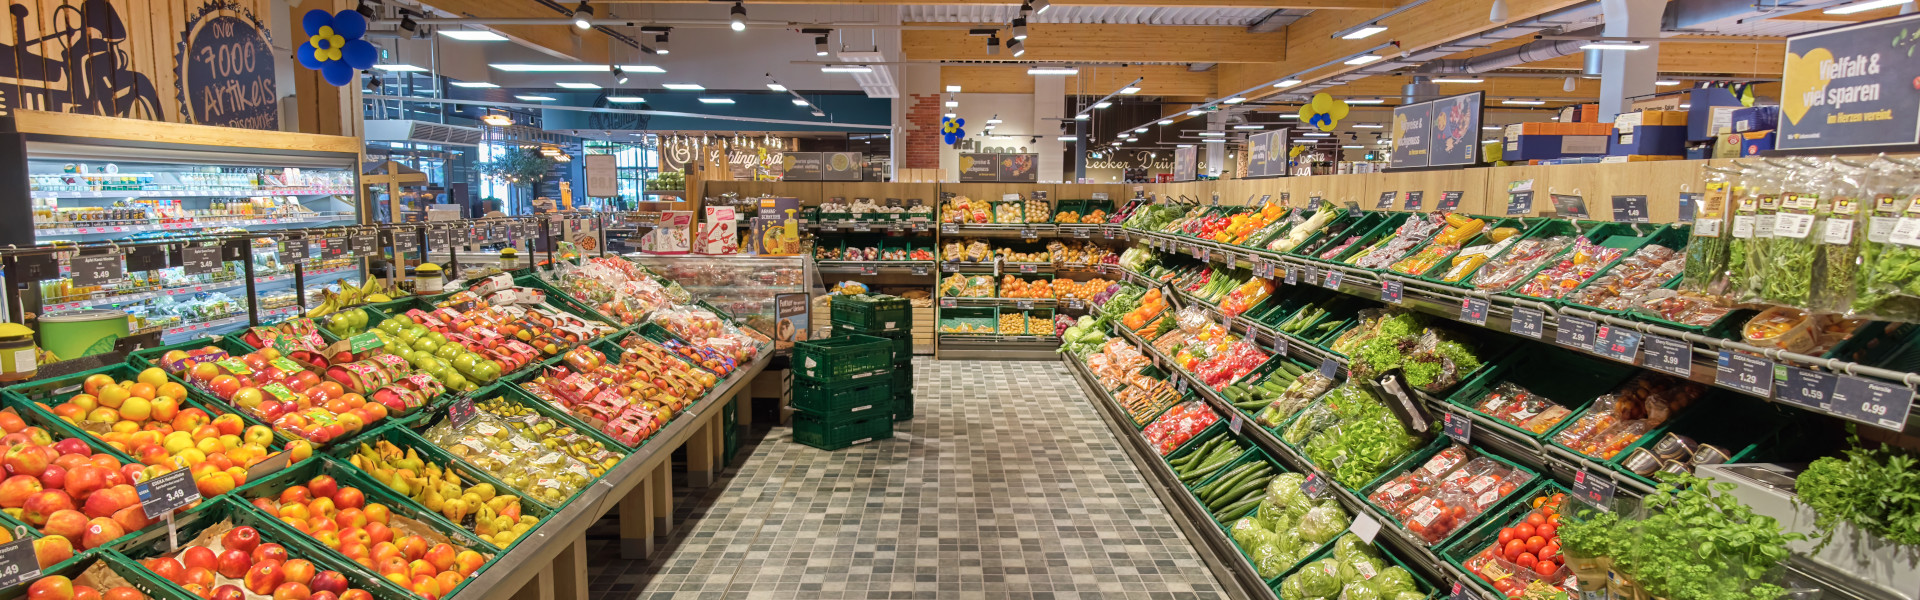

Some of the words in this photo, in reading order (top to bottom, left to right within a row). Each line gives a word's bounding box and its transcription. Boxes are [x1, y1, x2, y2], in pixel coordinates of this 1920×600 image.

[213, 22, 235, 39] over
[201, 41, 255, 79] 7000
[1819, 54, 1867, 80] Vielfalt
[1867, 53, 1880, 75] &
[204, 75, 275, 122] Artikels
[1803, 84, 1826, 107] viel
[1827, 83, 1880, 109] sparen
[1837, 112, 1863, 123] Herzen
[200, 261, 213, 269] 3.49
[93, 270, 110, 279] 3.49
[1663, 355, 1678, 365] 3.99
[1739, 372, 1757, 384] 1.29
[1802, 387, 1824, 400] 0.59
[1861, 401, 1887, 416] 0.99
[166, 489, 185, 502] 3.49
